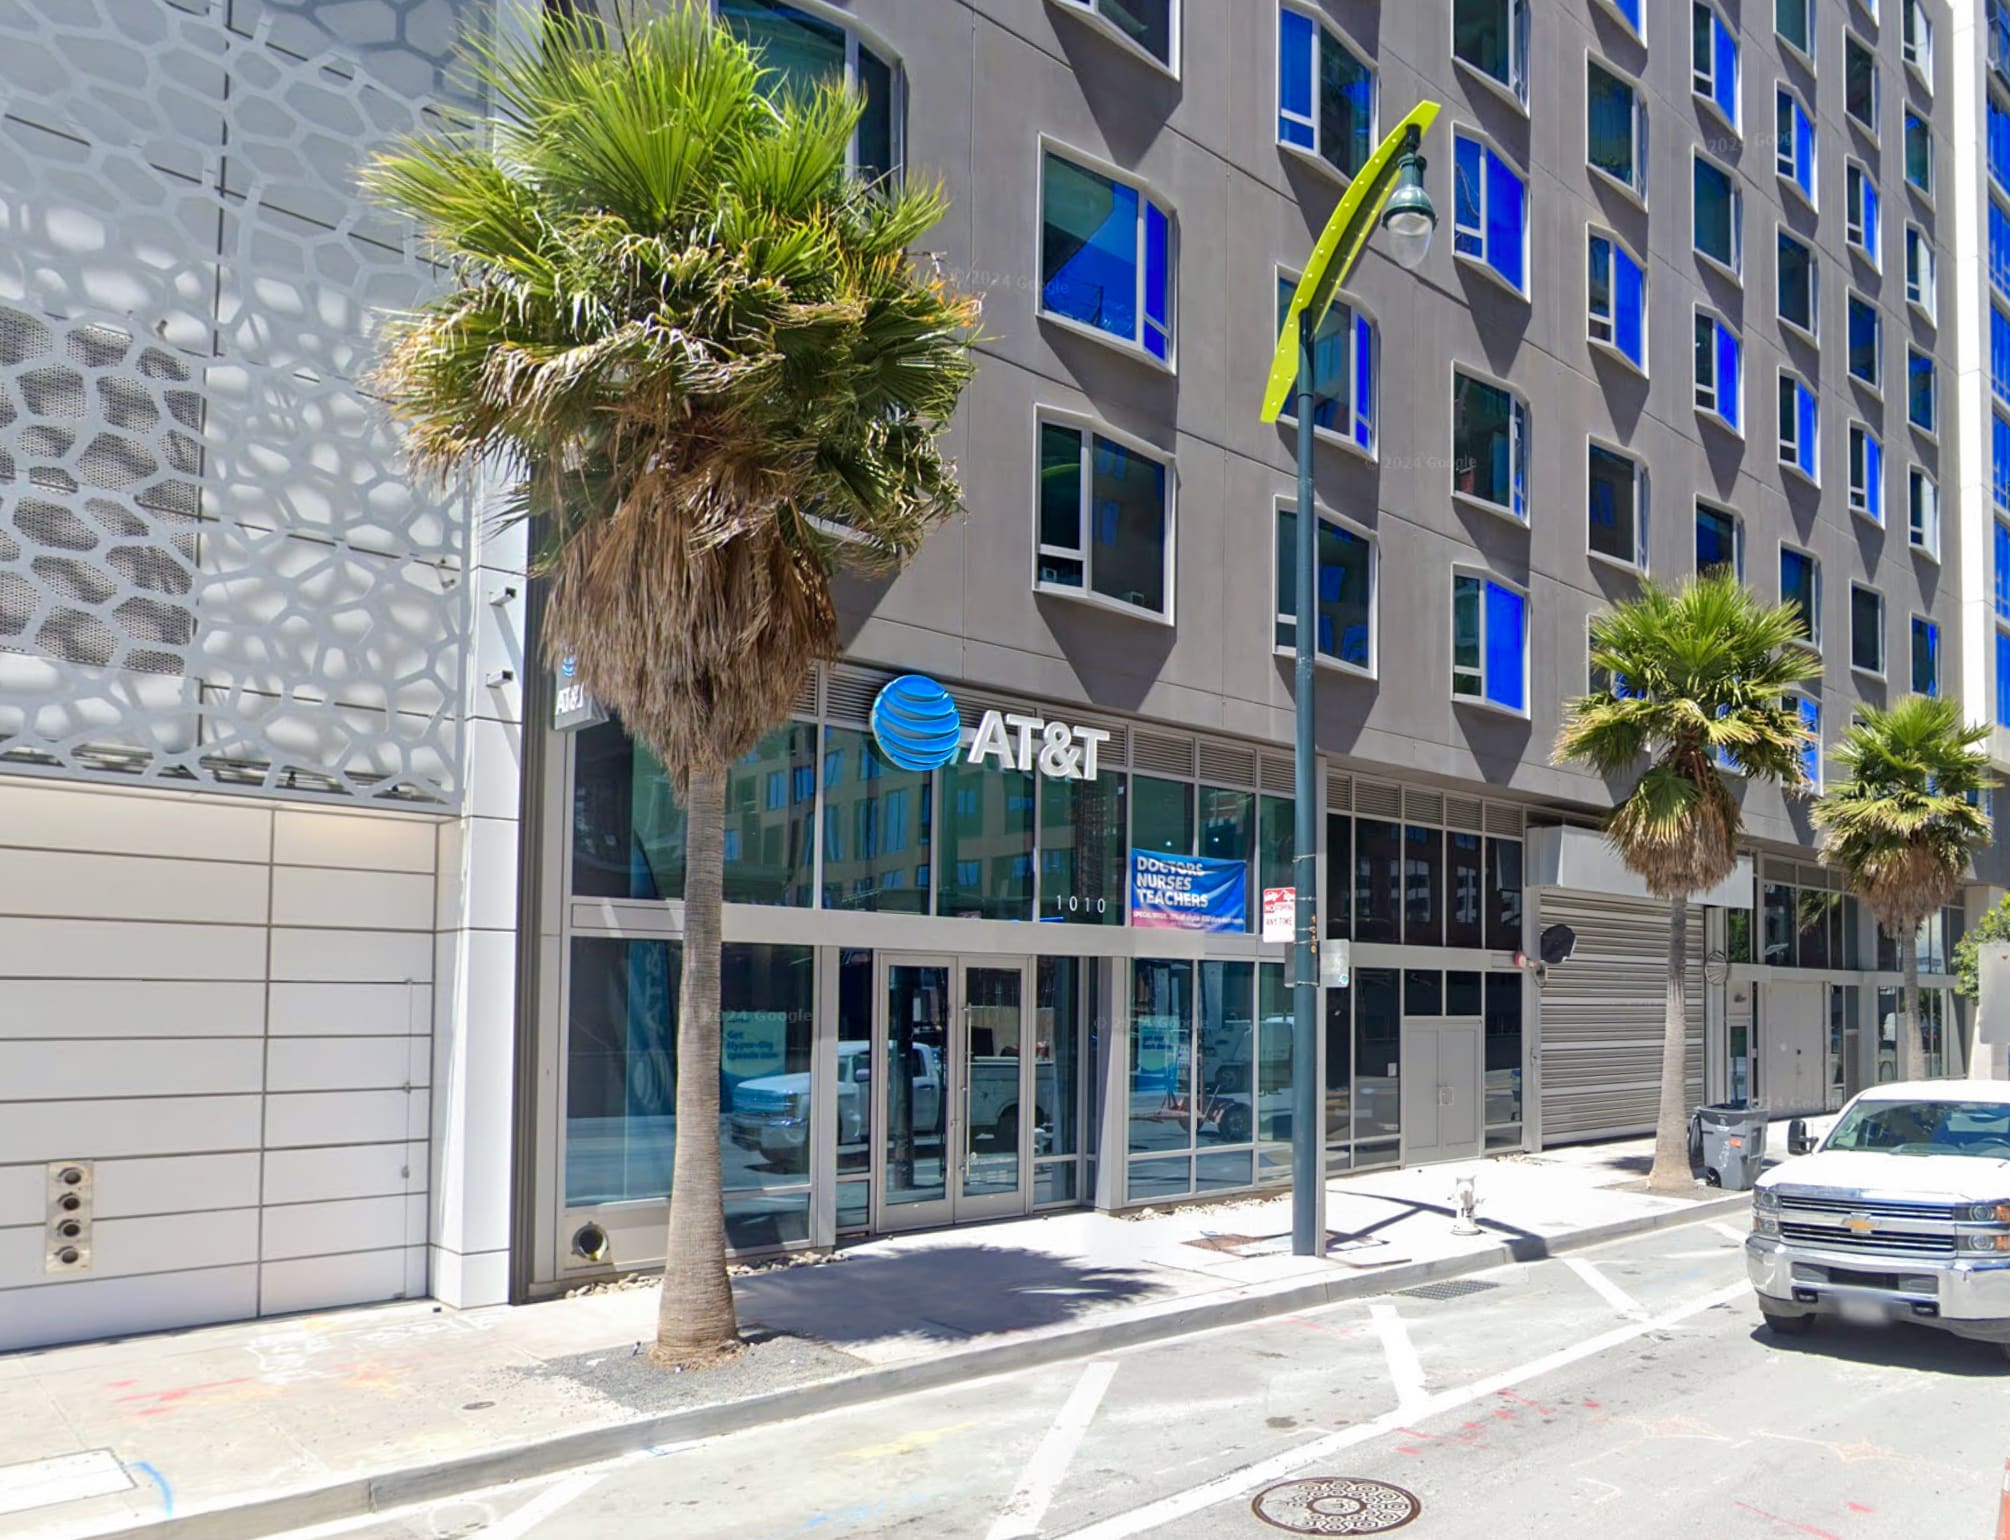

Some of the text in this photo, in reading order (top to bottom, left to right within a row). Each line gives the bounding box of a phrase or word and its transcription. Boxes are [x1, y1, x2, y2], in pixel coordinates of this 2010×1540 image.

[967, 709, 1111, 781] AT&T
[1136, 855, 1205, 877] DOCTORS
[1136, 872, 1192, 891] NURSES
[1056, 894, 1106, 914] 1010
[1136, 888, 1209, 908] TEACHERS
[1280, 916, 1293, 926] TIME
